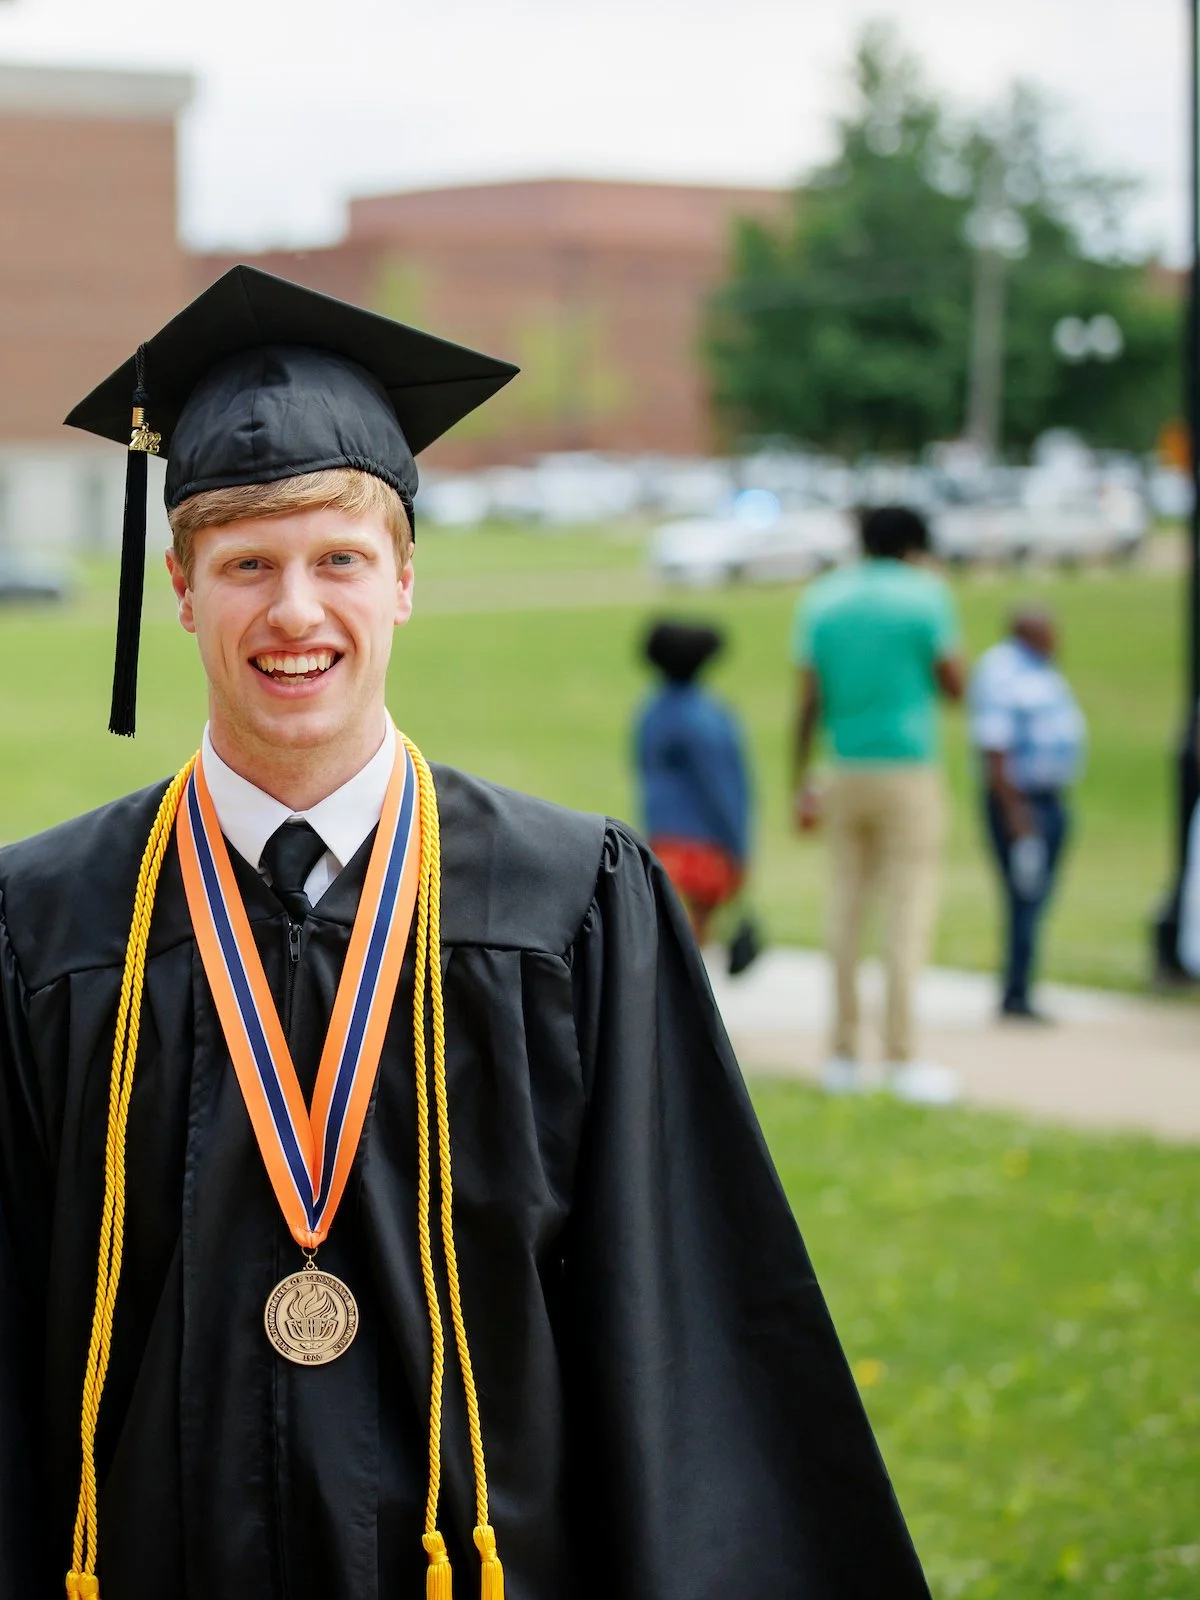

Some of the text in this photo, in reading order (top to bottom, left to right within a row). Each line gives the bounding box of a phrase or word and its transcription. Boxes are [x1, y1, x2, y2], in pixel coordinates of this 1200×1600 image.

[129, 429, 161, 454] 2022
[268, 1275, 356, 1355] THE UNIVERSITY OF TENNESSEE AT MARTIN
